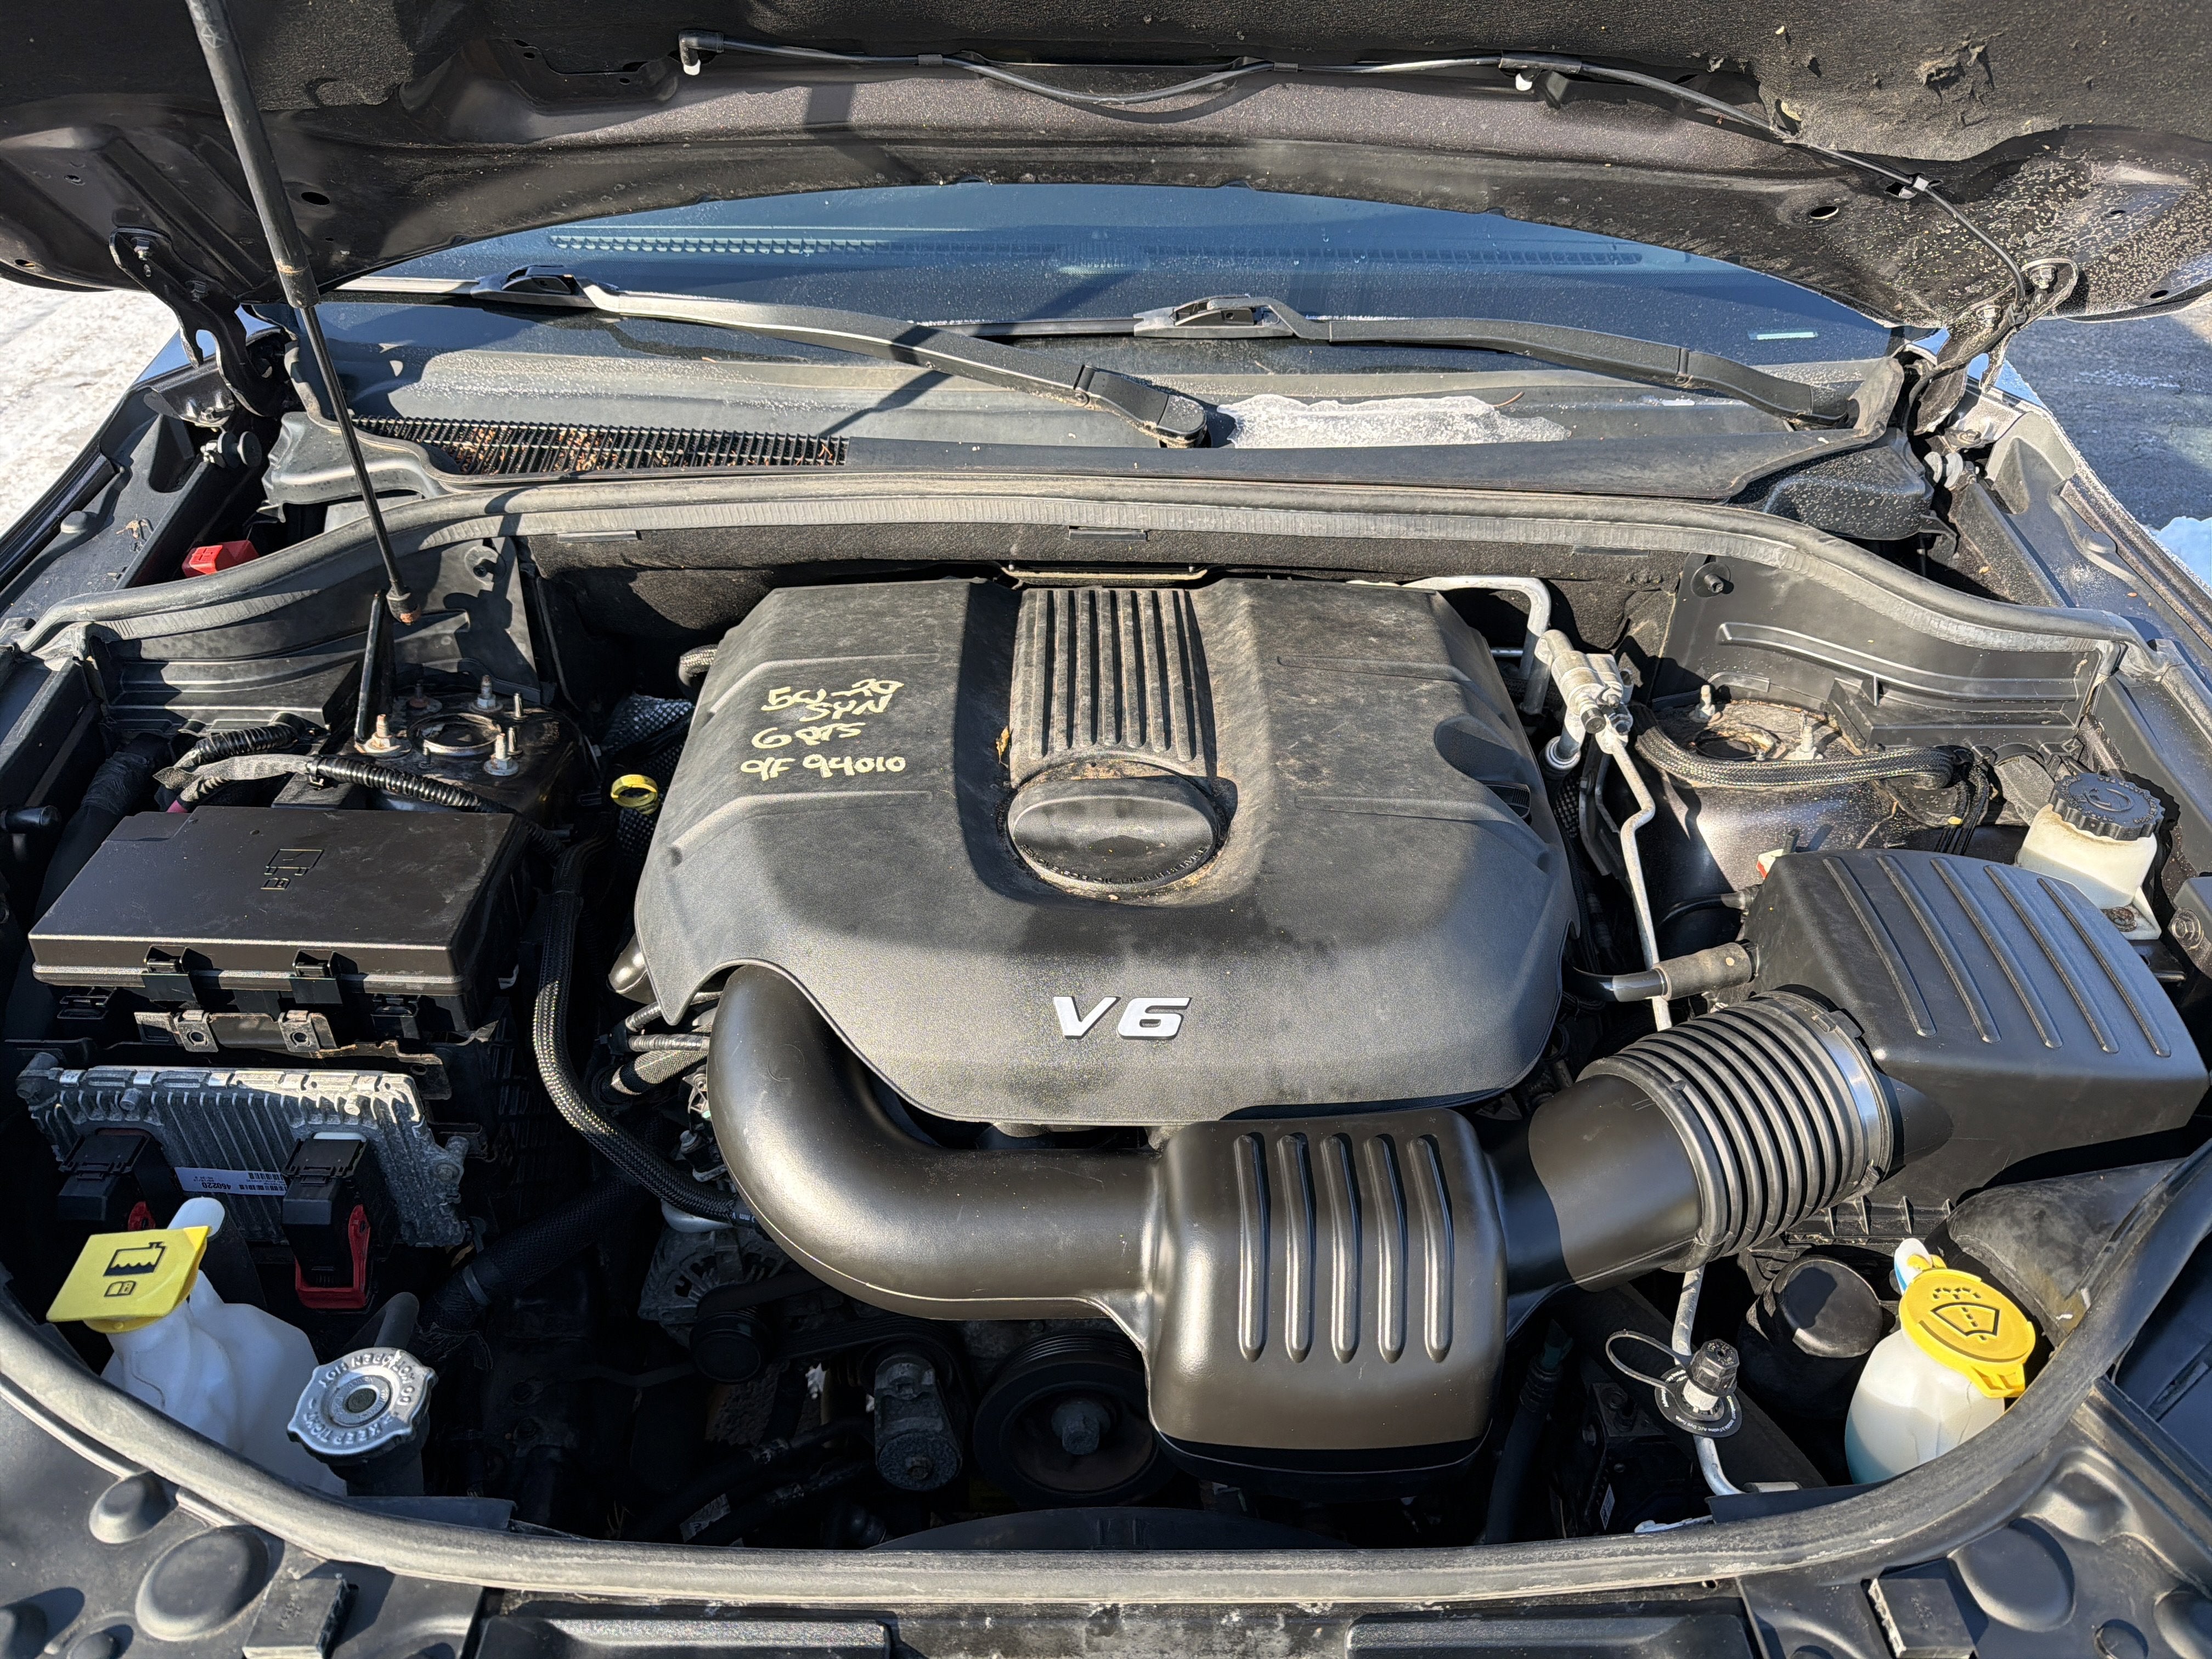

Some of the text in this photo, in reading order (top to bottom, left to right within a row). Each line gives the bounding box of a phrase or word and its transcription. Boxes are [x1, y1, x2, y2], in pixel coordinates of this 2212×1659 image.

[751, 727, 792, 749] 6
[803, 754, 906, 778] 94010
[1053, 996, 1192, 1040] V6
[351, 1353, 392, 1367] OPEN
[319, 1362, 349, 1387] HOT
[303, 1412, 382, 1445] KEEP TIGHT
